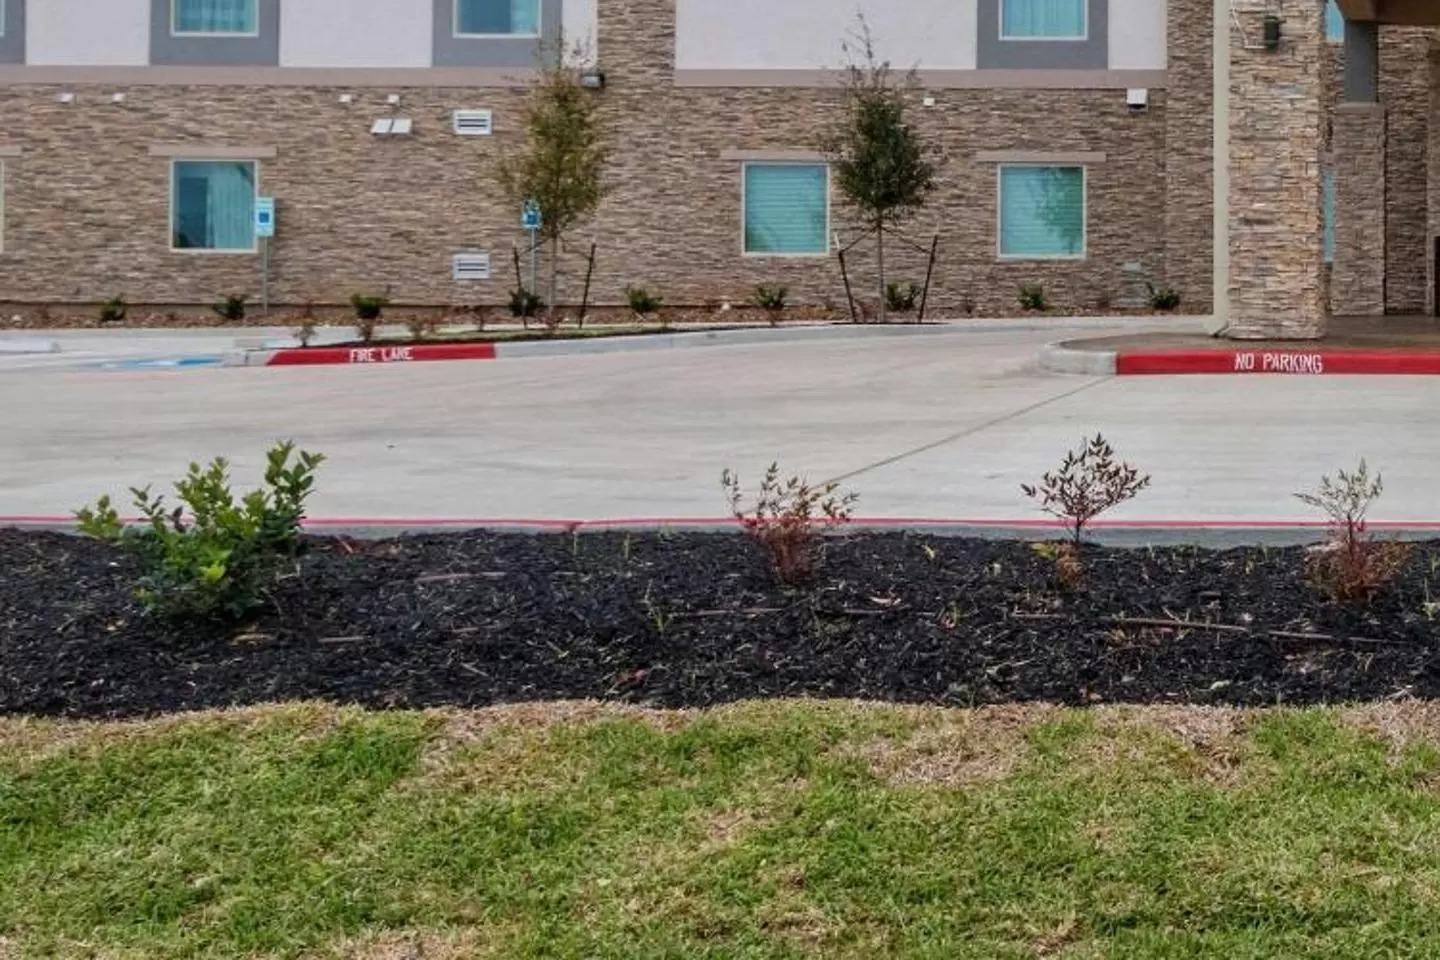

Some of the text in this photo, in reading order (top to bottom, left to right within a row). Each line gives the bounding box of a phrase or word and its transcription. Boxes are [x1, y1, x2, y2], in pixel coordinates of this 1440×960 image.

[349, 346, 414, 362] FIRE LANE
[1234, 352, 1324, 373] NO PARKING
